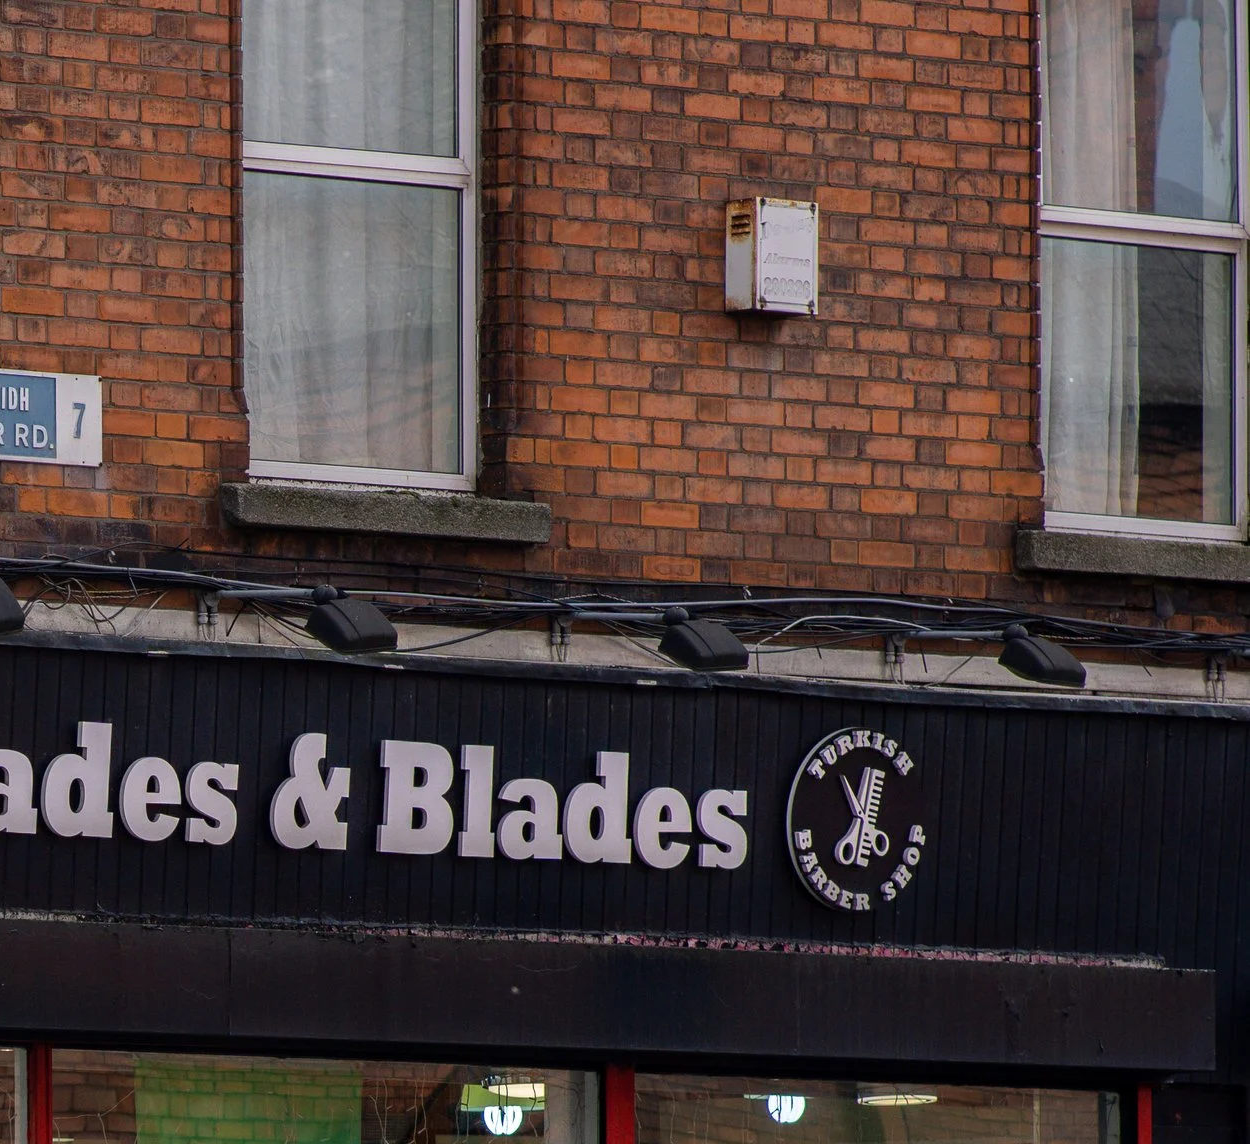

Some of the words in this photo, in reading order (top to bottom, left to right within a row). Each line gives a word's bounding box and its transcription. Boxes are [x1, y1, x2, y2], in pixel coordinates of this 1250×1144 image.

[15, 424, 54, 450] RD.
[72, 402, 86, 440] 7
[807, 730, 914, 780] TURKISH
[270, 732, 350, 851] &
[376, 739, 748, 869] Blades
[795, 829, 871, 911] BARBER
[881, 824, 926, 902] SHOP
